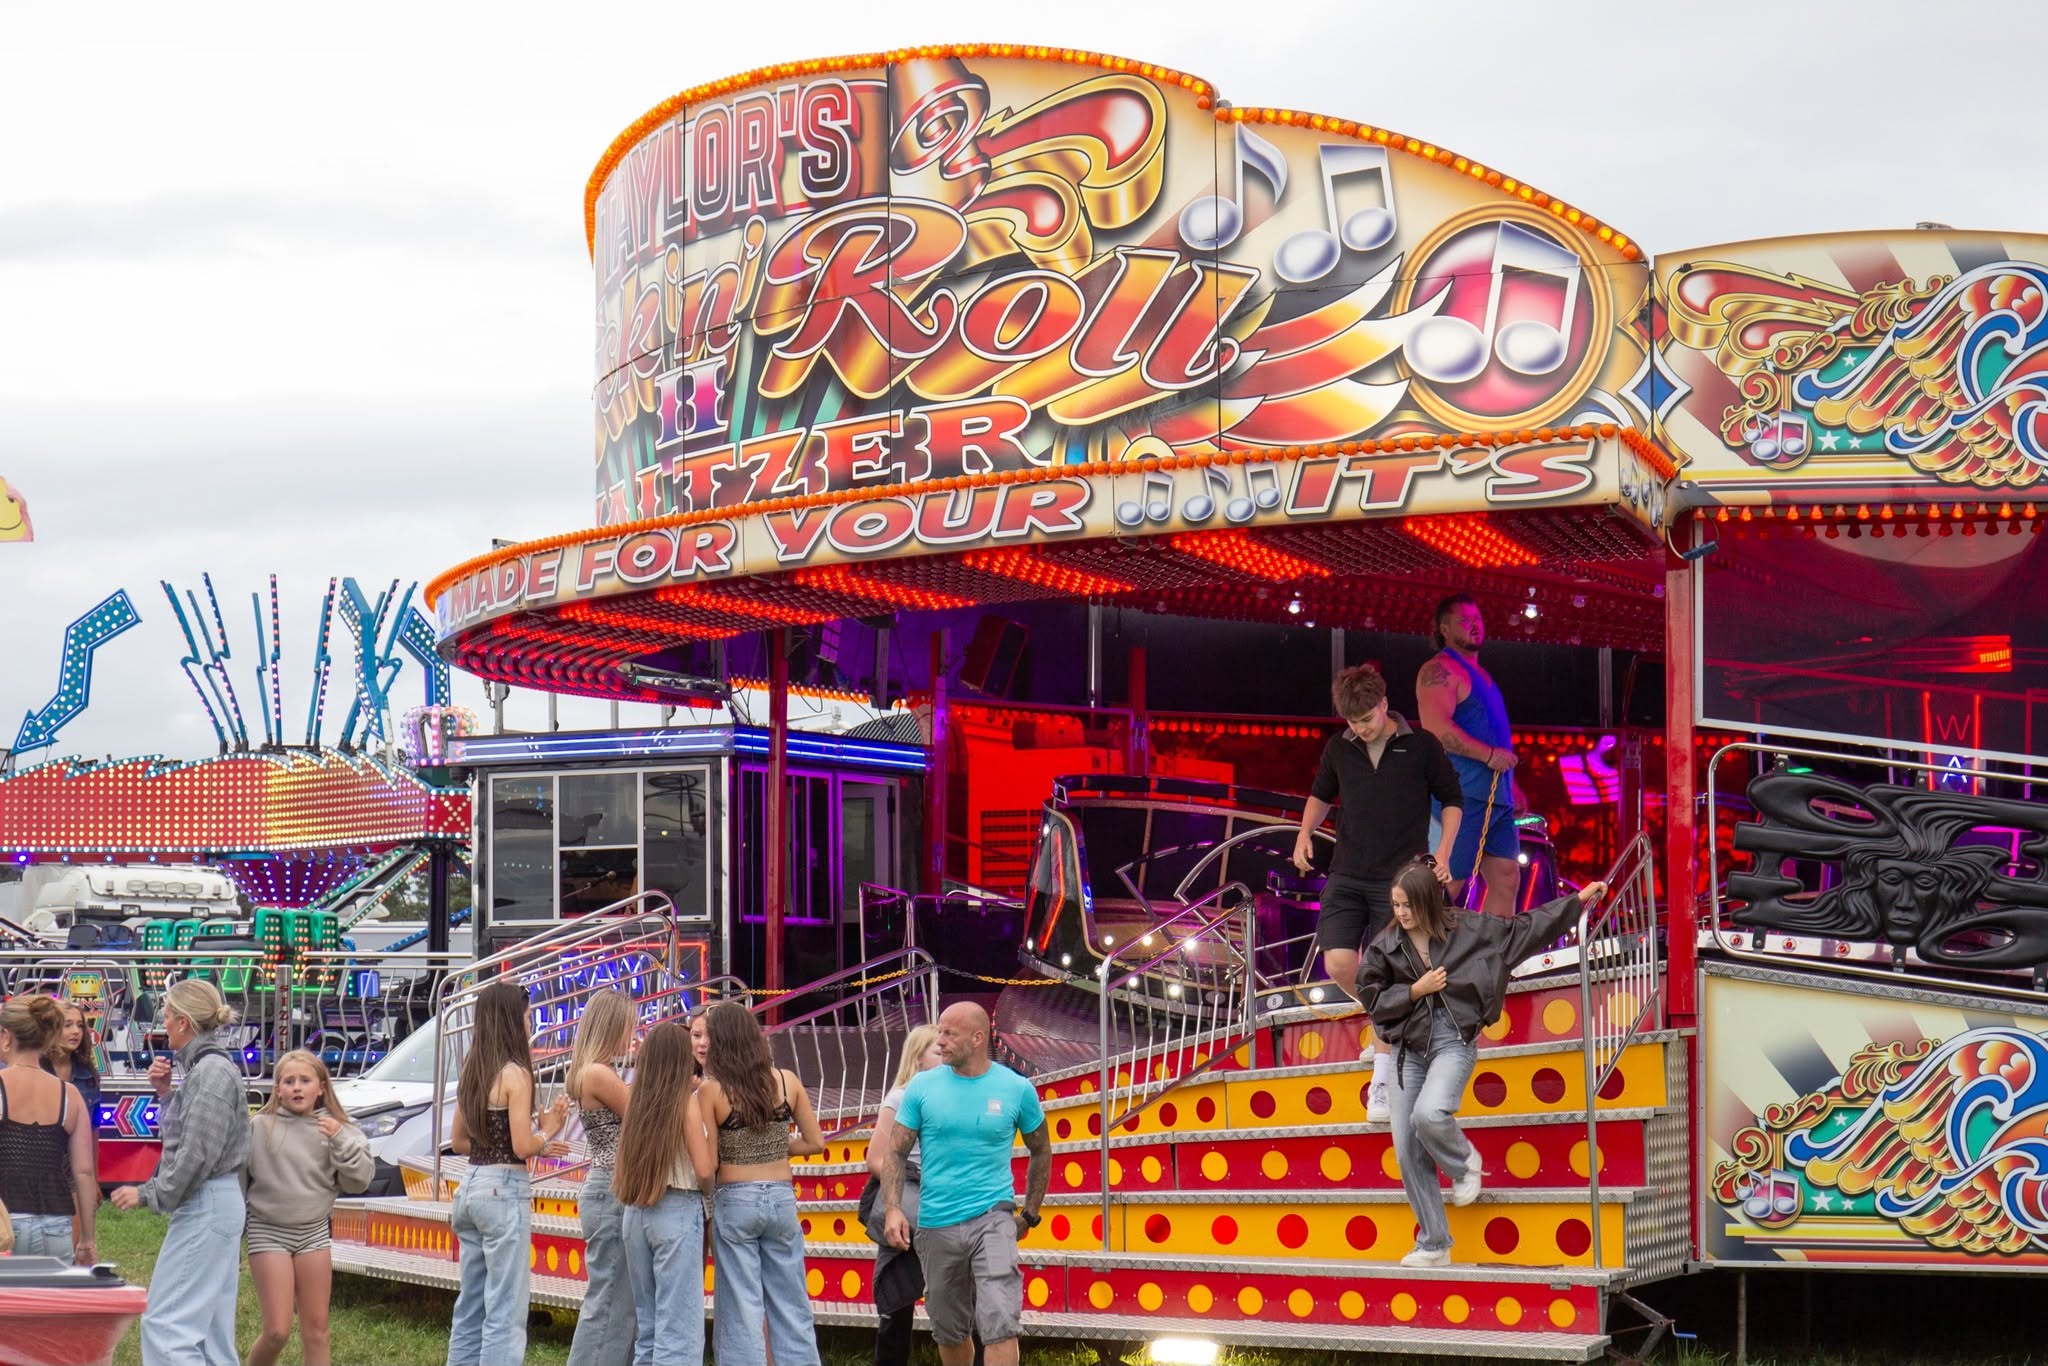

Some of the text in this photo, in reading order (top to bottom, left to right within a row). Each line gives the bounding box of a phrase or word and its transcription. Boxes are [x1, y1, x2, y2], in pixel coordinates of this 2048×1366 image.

[599, 77, 853, 284] TAYLOR'S
[766, 196, 1262, 391] Roll
[449, 436, 1596, 626] MADE FOR YOUR IT'S
[597, 397, 1053, 525] ALTZER
